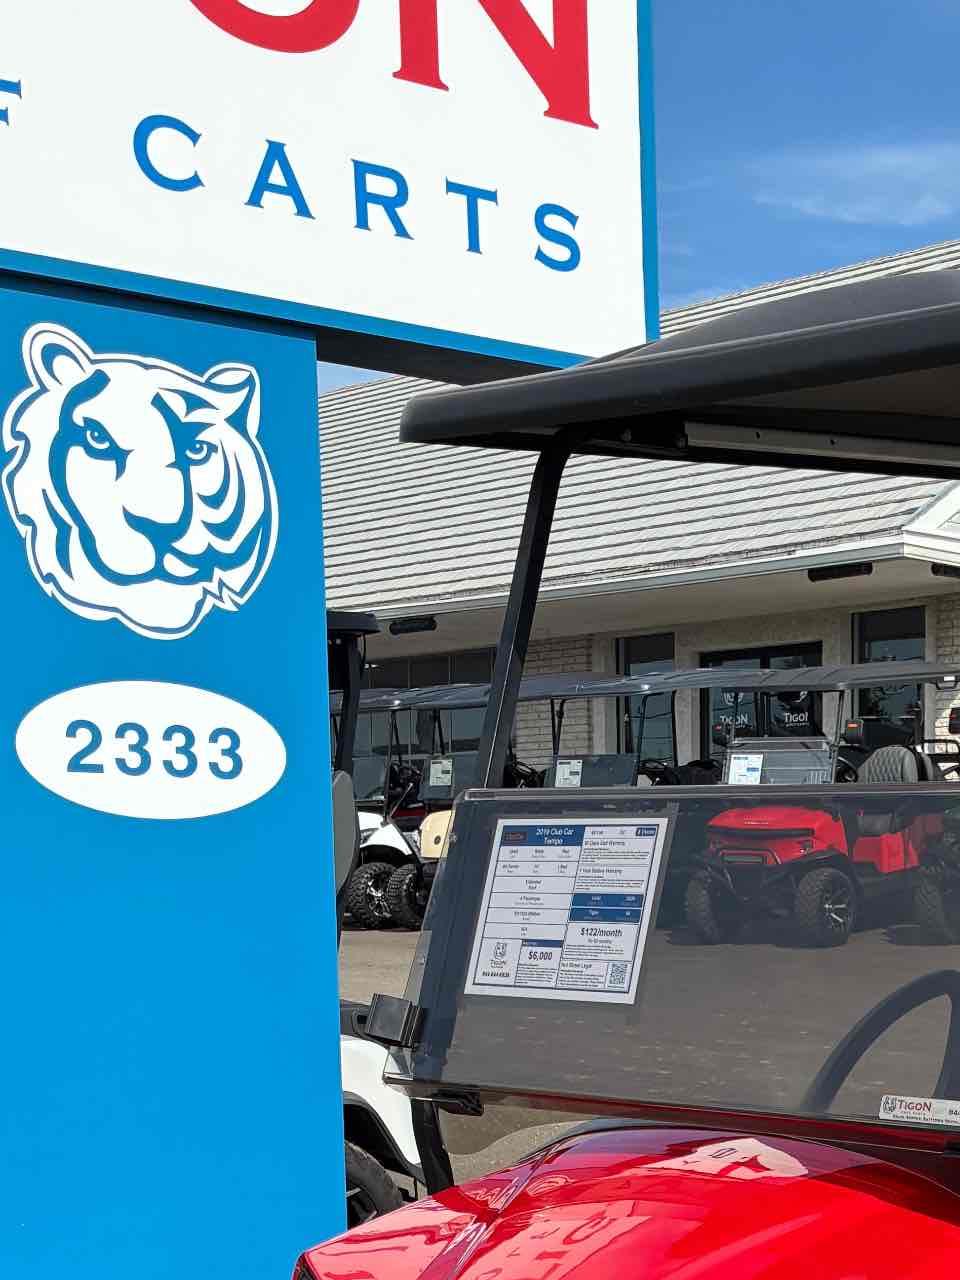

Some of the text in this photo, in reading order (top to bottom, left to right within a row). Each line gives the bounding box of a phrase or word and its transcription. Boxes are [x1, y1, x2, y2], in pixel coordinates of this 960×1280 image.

[132, 113, 582, 273] CARTS
[64, 719, 244, 779] 2333
[550, 827, 562, 836] Club
[563, 827, 575, 836] Car
[579, 926, 624, 938] $122/month
[528, 951, 554, 962] $6,000
